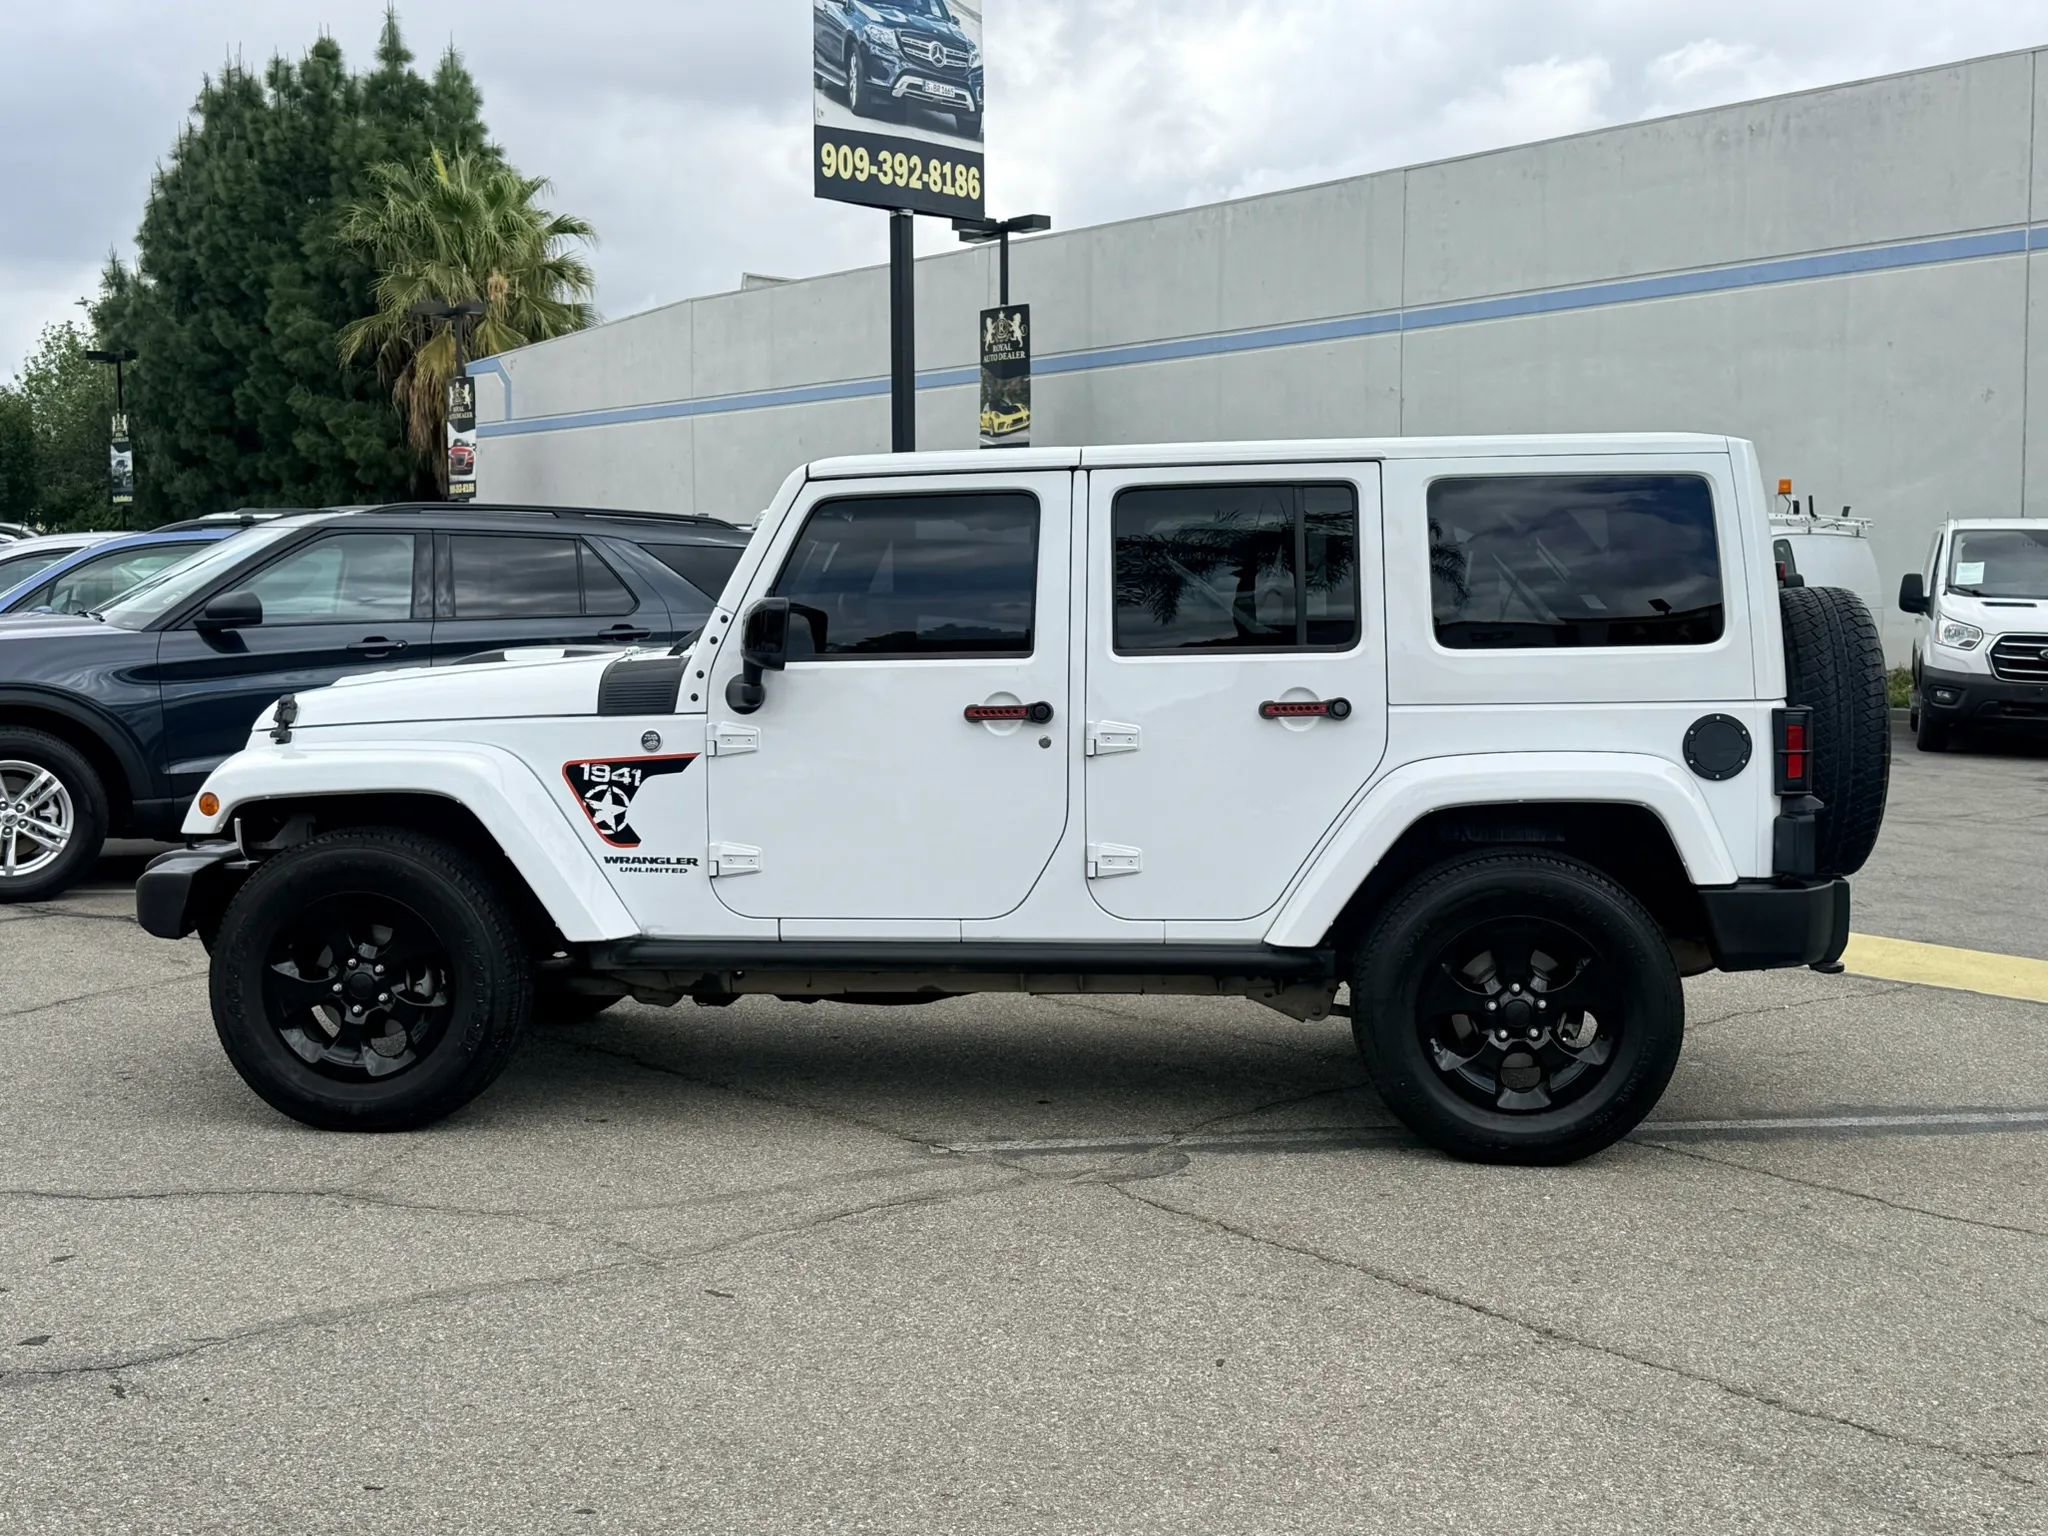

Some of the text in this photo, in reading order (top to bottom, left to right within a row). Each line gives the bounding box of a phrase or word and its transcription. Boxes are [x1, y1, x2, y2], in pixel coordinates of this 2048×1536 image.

[821, 142, 981, 200] 909-392-8186
[992, 343, 1012, 352] ROYAL
[579, 763, 642, 787] 1941
[603, 856, 699, 866] WRANGLER
